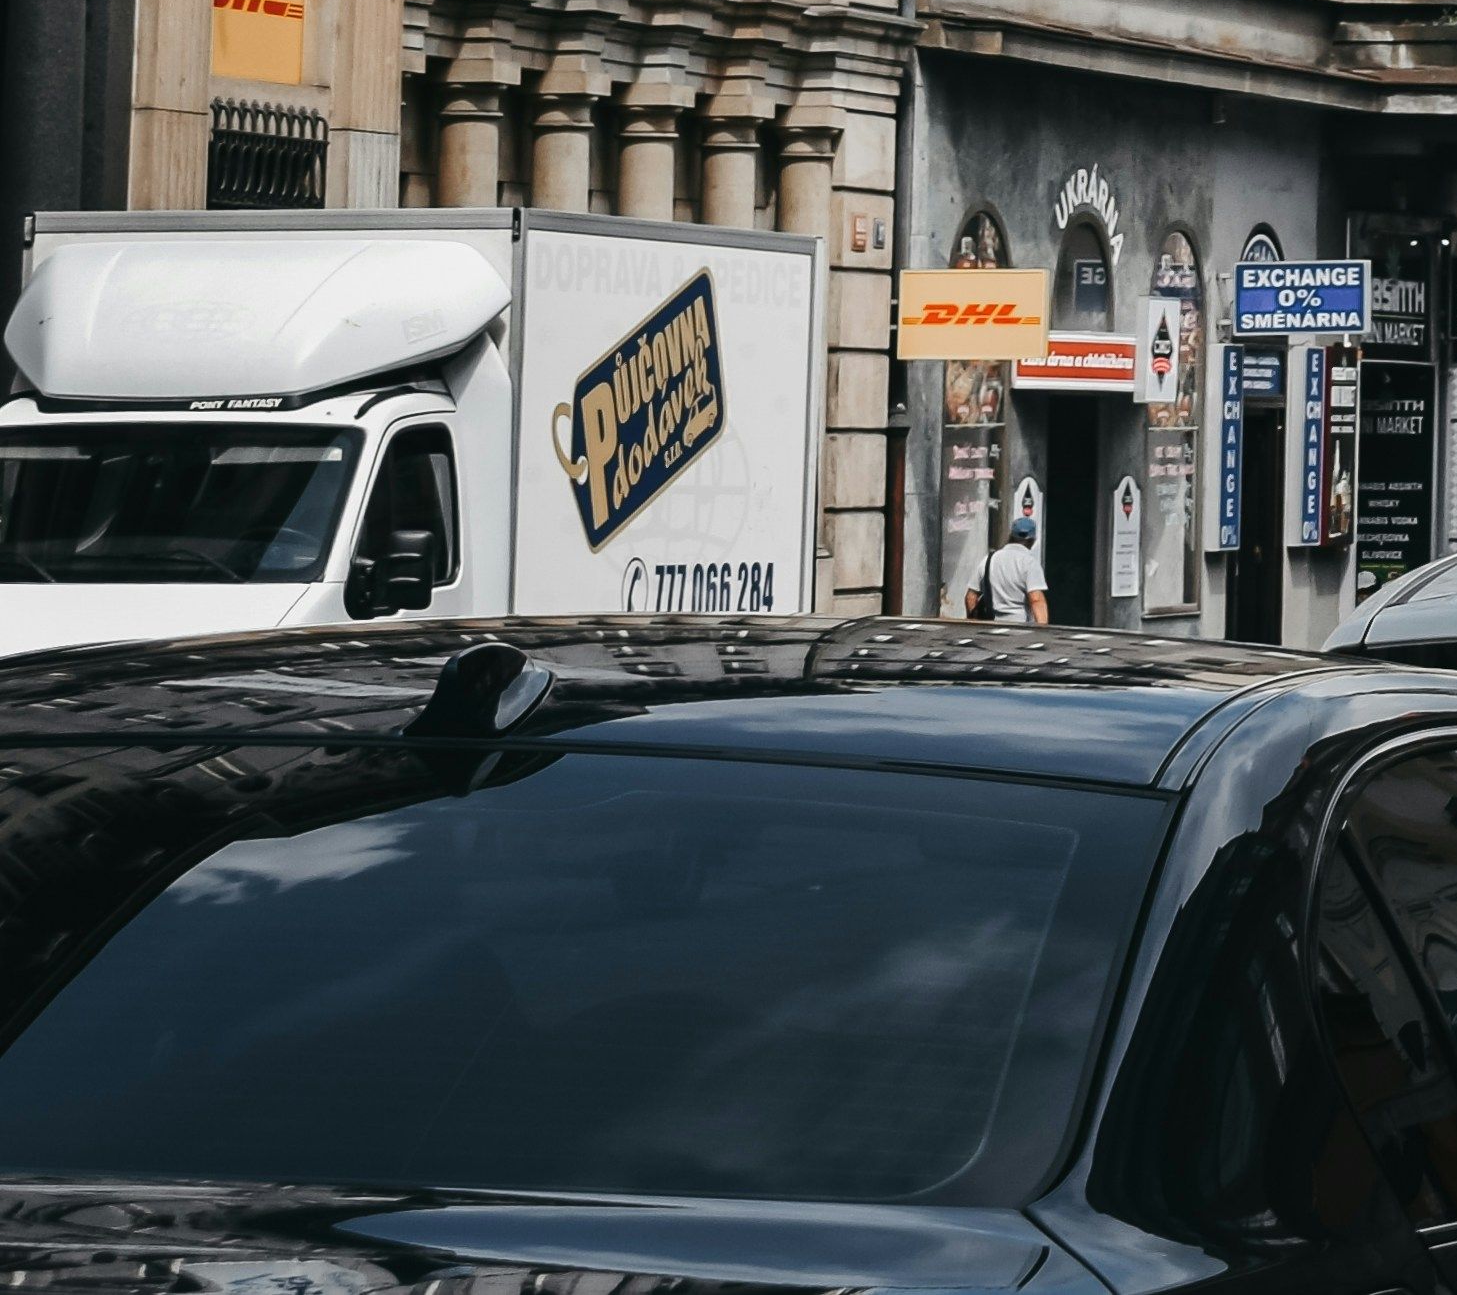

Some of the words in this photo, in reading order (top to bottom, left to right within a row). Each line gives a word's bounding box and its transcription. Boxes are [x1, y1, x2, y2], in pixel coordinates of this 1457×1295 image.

[535, 241, 663, 299] DOPRAVA
[1242, 267, 1361, 288] EXCHANGE
[1277, 289, 1322, 307] 0%
[920, 303, 1024, 325] DHL
[189, 400, 224, 410] PONY
[227, 397, 283, 409] FANTASY
[1223, 351, 1241, 518] EXCHANGE
[1305, 354, 1322, 515] EXCHANGE
[1376, 415, 1424, 435] MARKET
[654, 561, 690, 613] 777
[691, 561, 732, 613] 066
[737, 561, 775, 613] 284
